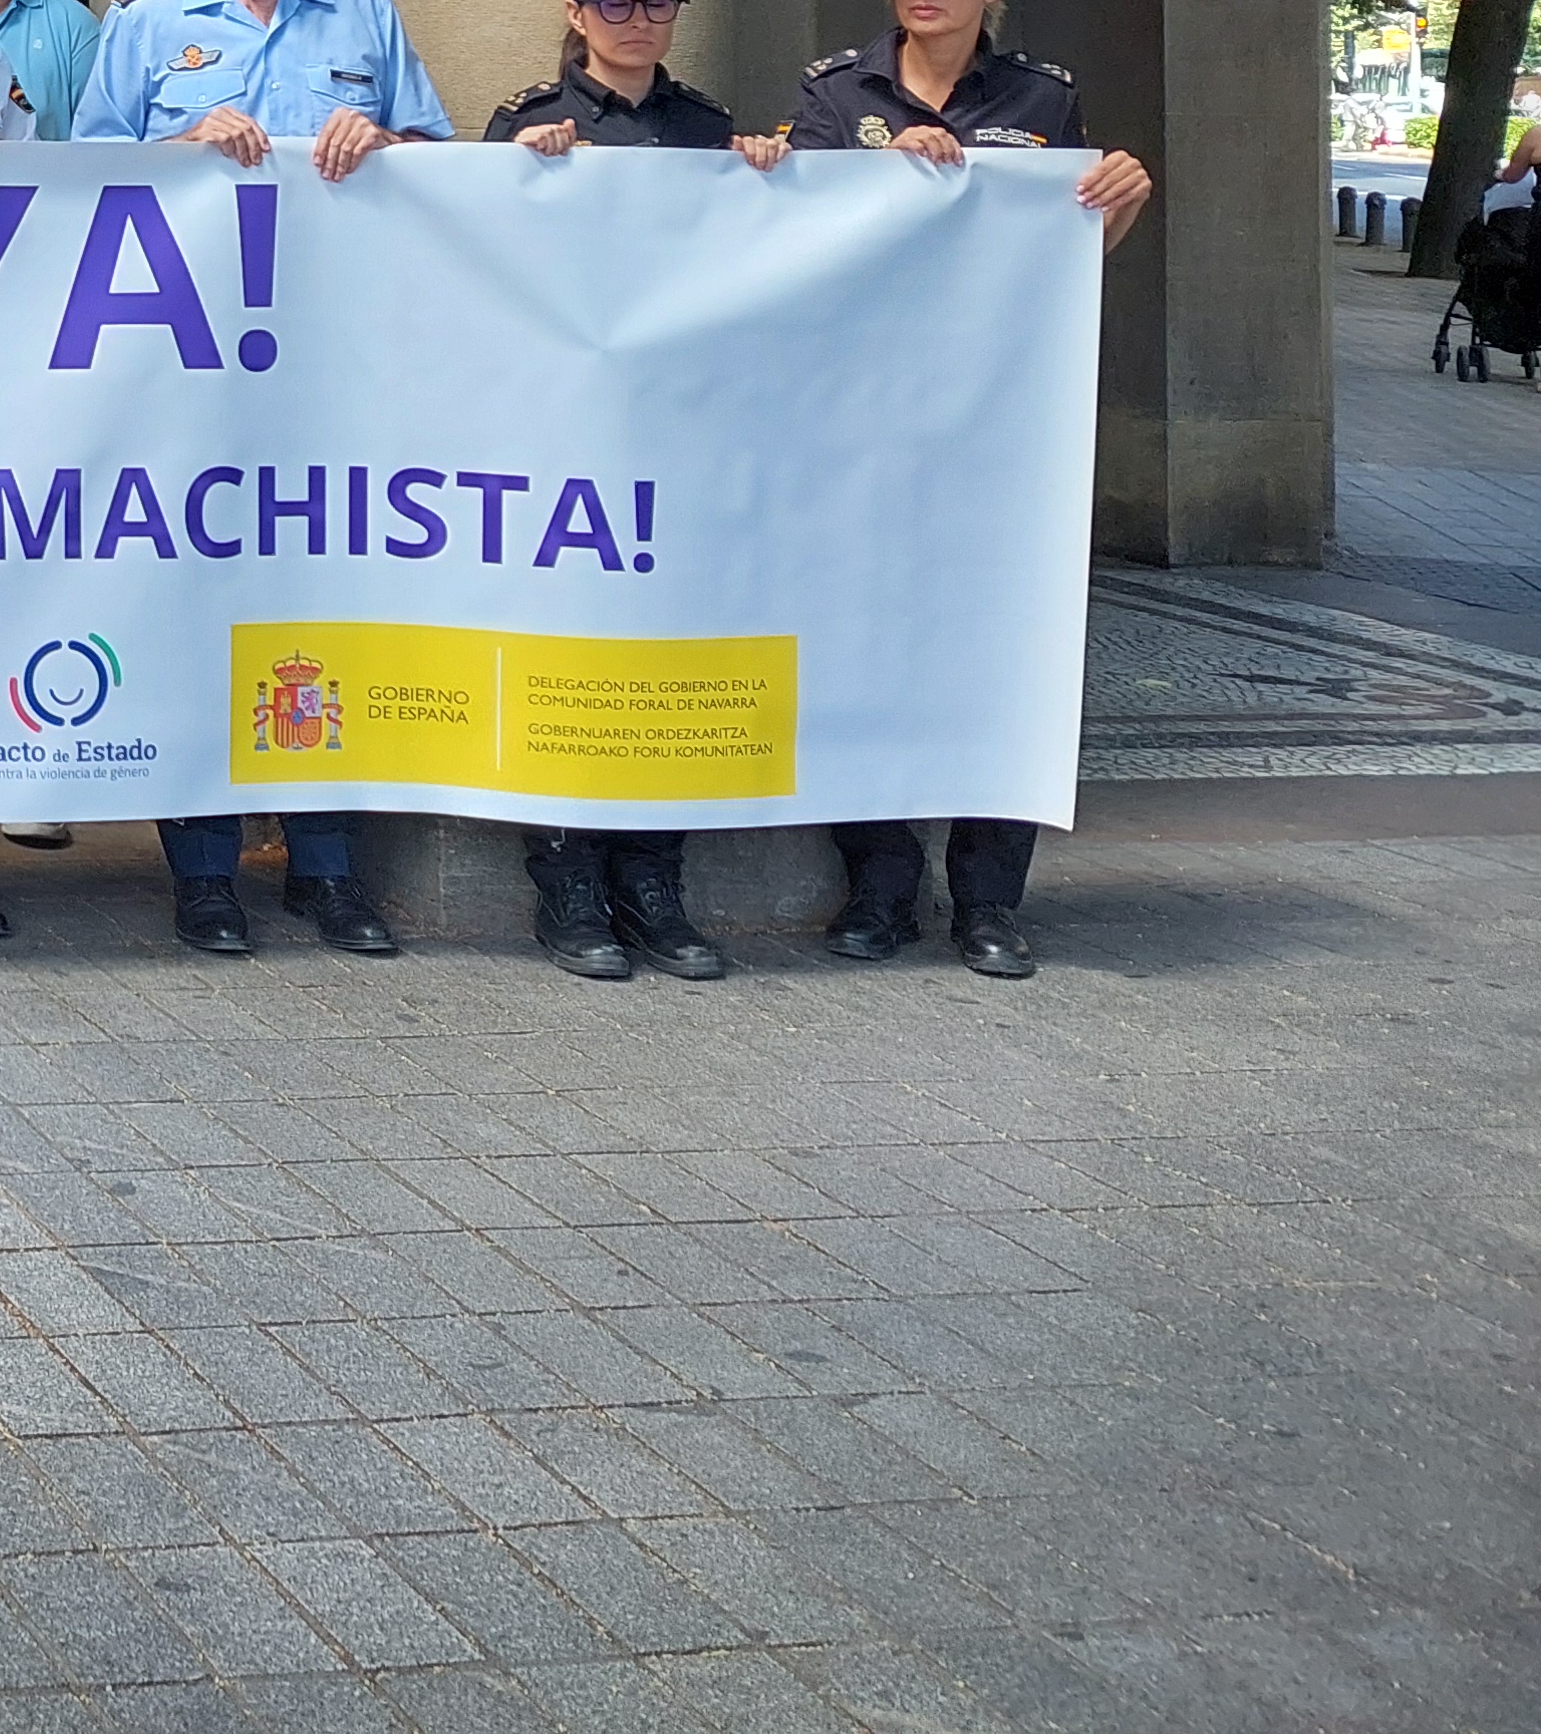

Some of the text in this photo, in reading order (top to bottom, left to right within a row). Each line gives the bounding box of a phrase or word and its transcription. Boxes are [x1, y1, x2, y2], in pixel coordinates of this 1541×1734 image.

[528, 675, 768, 694] DELEGACIÓN DEL GOBIERNO EN LA
[367, 685, 470, 705] GOBIERNO
[528, 694, 758, 711] COMUNIDAD FORAL DE NAVARRA
[368, 704, 469, 725] DE ESPAÑA
[528, 722, 748, 741] GOBERNUAREN ORDEZKARITZA
[52, 749, 70, 763] de
[75, 738, 158, 763] Estado
[527, 741, 774, 758] NAFARROAKO FORU KOMUNITATEAN
[26, 768, 37, 779] la
[40, 767, 91, 780] violencia
[93, 767, 107, 779] de
[110, 766, 150, 782] género
